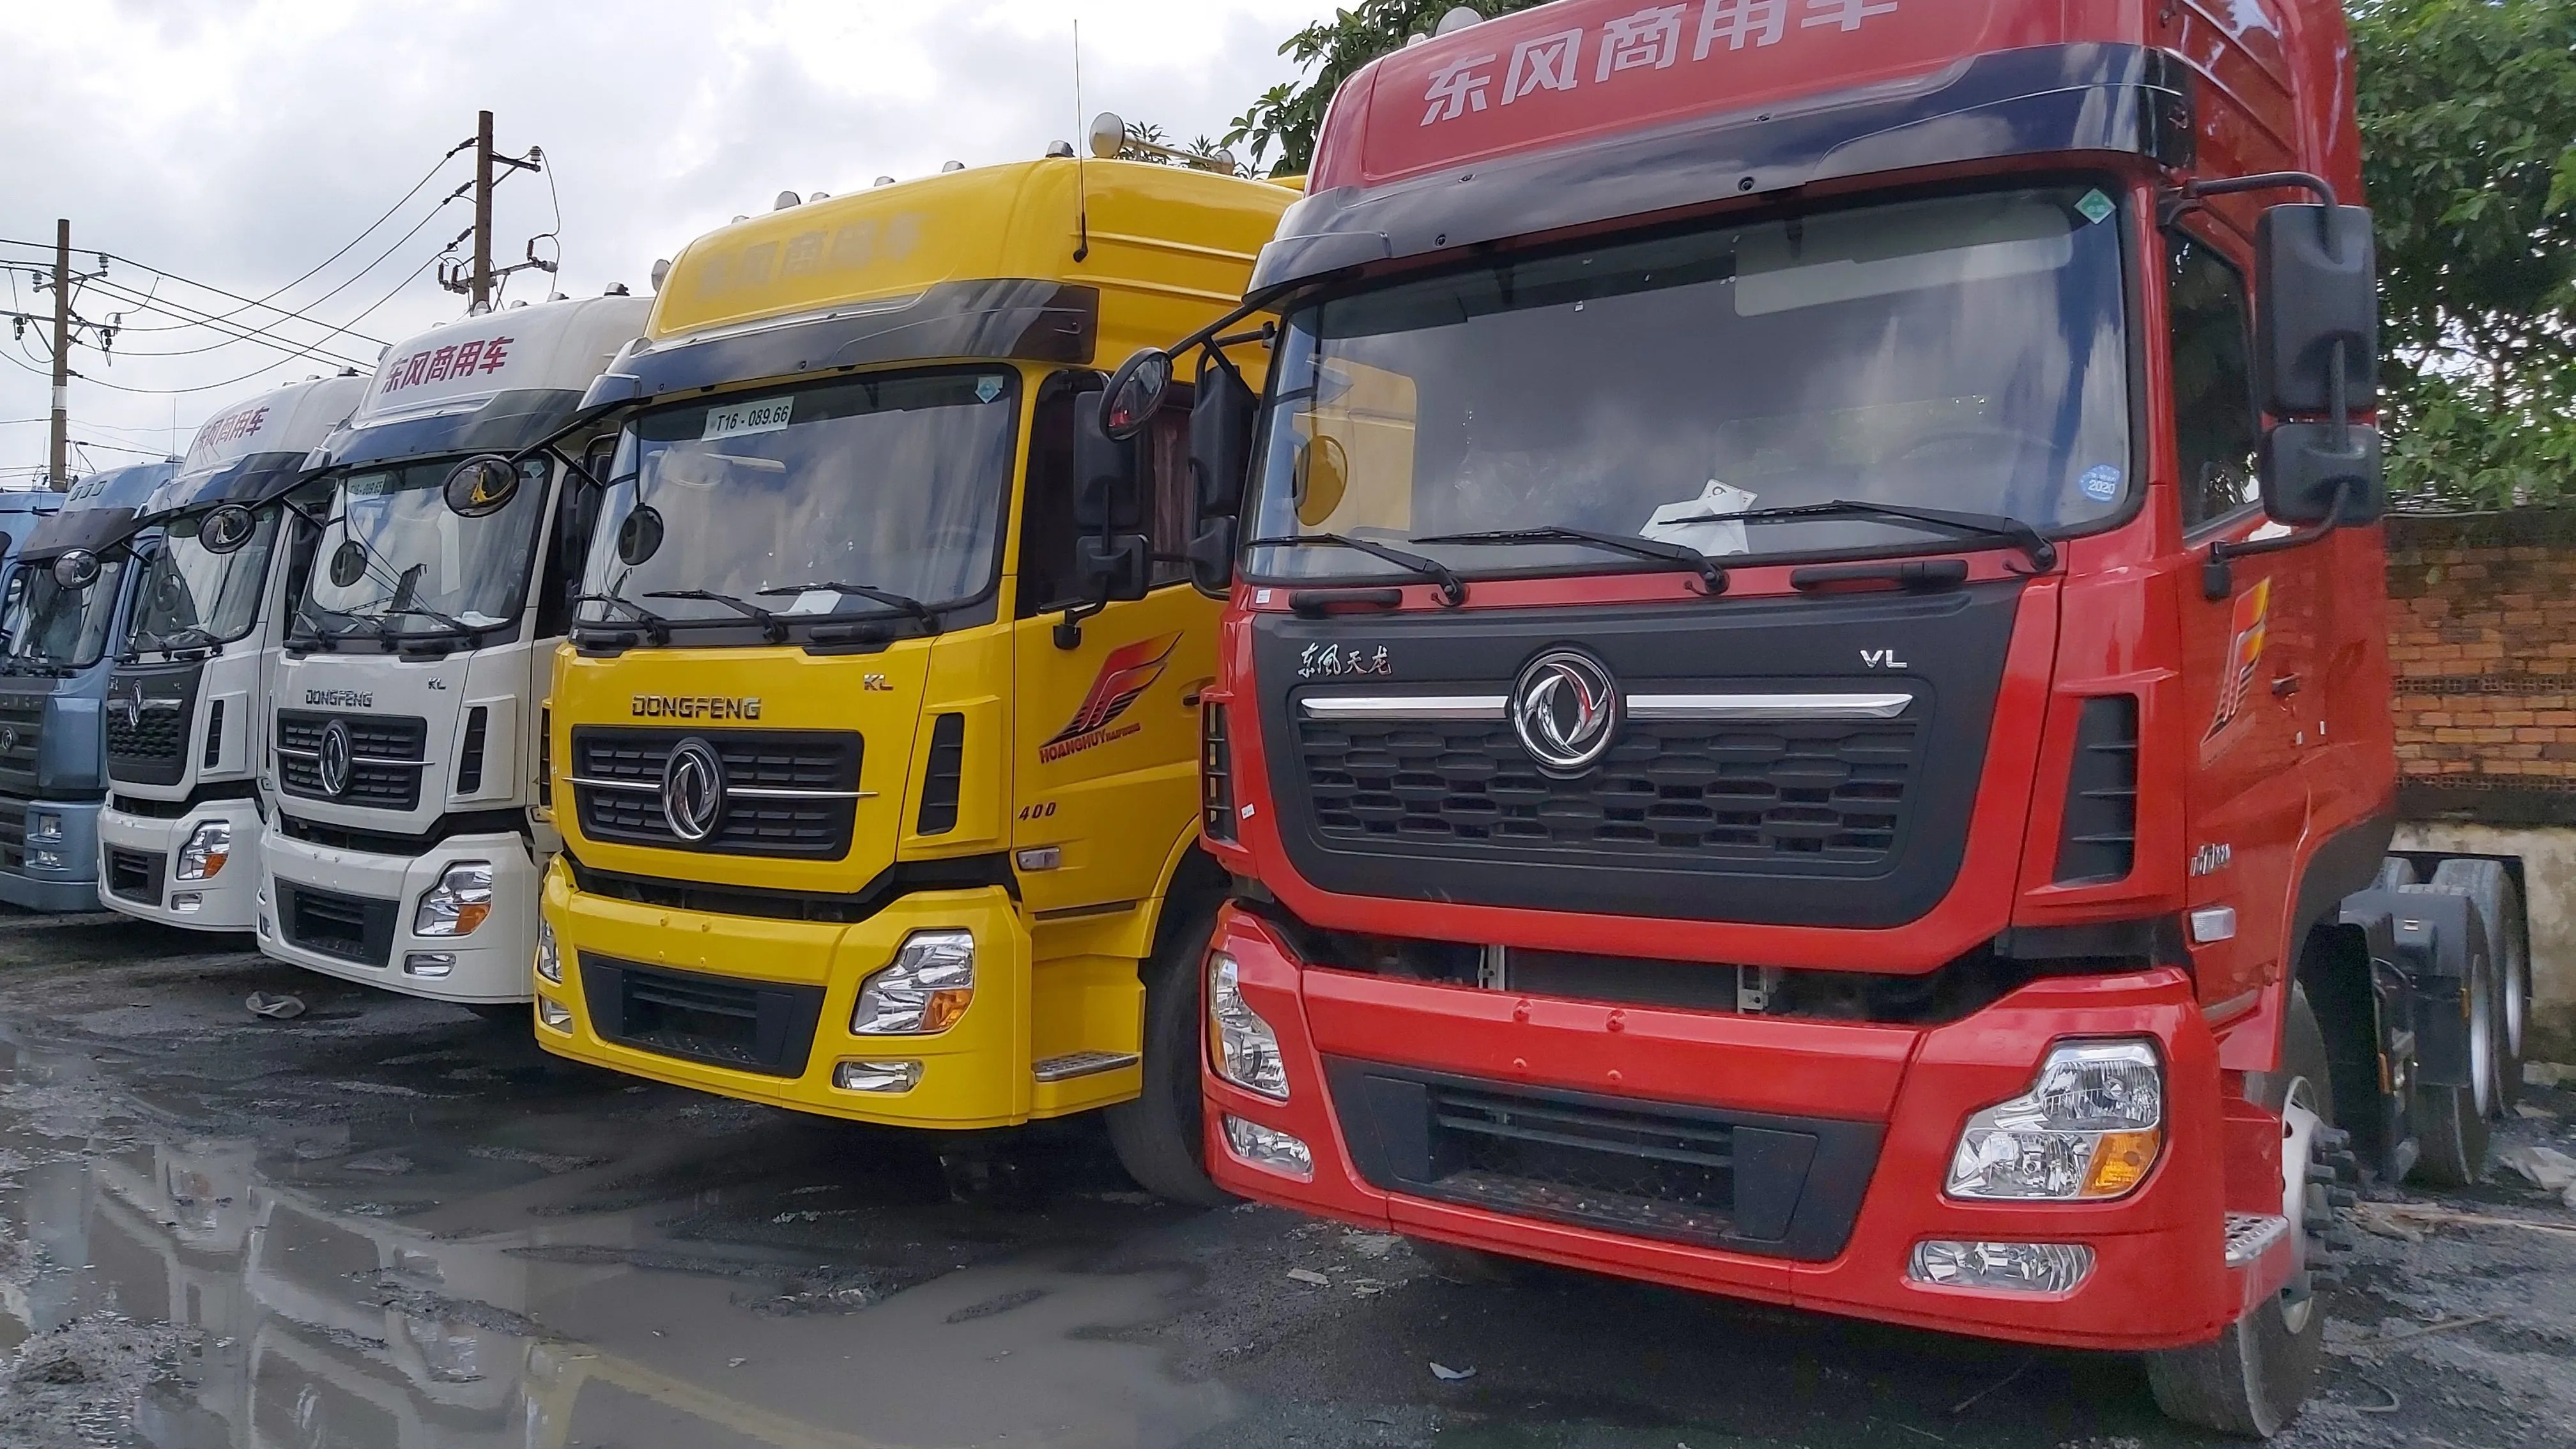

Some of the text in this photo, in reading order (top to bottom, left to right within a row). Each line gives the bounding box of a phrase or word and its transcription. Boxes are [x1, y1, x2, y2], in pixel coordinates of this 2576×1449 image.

[380, 336, 514, 394] 东风商用车
[747, 405, 789, 427] 089.66
[2087, 479, 2115, 494] 2020
[1860, 649, 1908, 668] VL
[427, 677, 447, 690] KL
[863, 674, 894, 691] KL
[305, 689, 373, 707] DONGFENG
[631, 694, 762, 719] DONGFENG
[1039, 728, 1106, 765] HOANGHUY
[1018, 802, 1057, 821] 400
